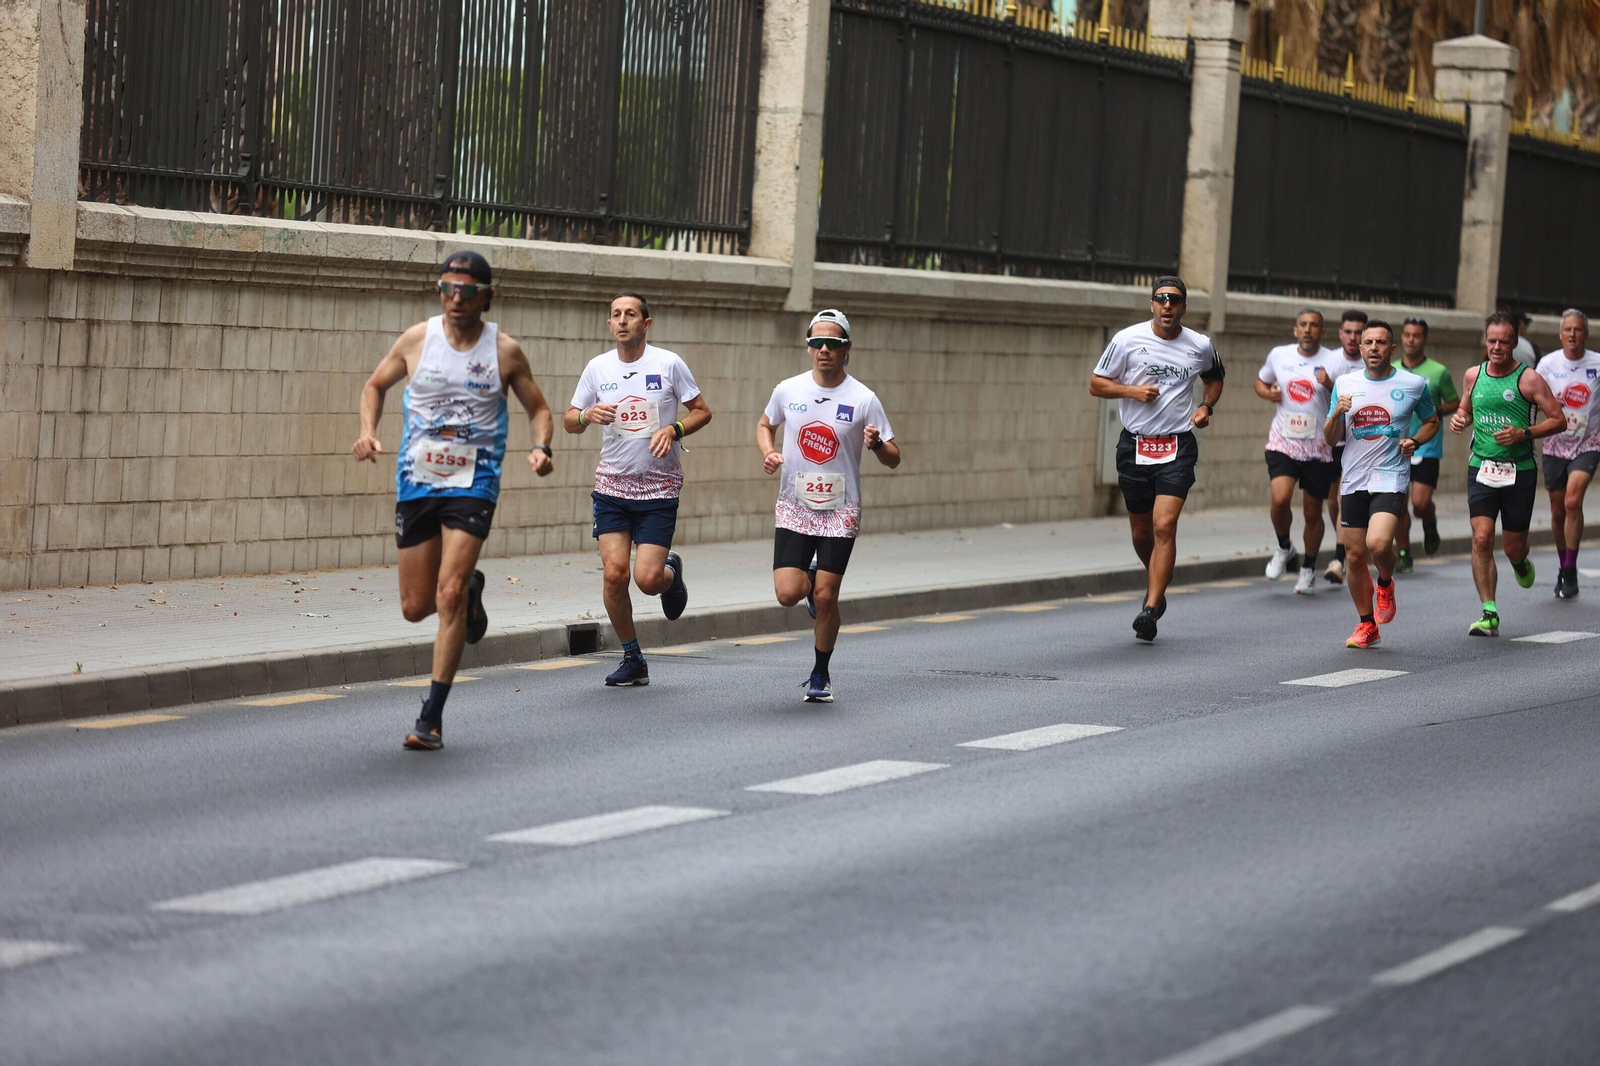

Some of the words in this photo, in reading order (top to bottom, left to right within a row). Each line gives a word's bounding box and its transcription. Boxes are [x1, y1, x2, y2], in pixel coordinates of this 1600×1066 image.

[620, 410, 648, 422] 923
[1479, 412, 1512, 425] mijas
[1290, 419, 1308, 427] 801
[804, 430, 835, 448] PONLE
[802, 439, 832, 455] FRENO
[1142, 443, 1172, 452] 2323
[424, 452, 467, 467] 1253
[1483, 466, 1511, 477] 1172
[806, 482, 834, 493] 247
